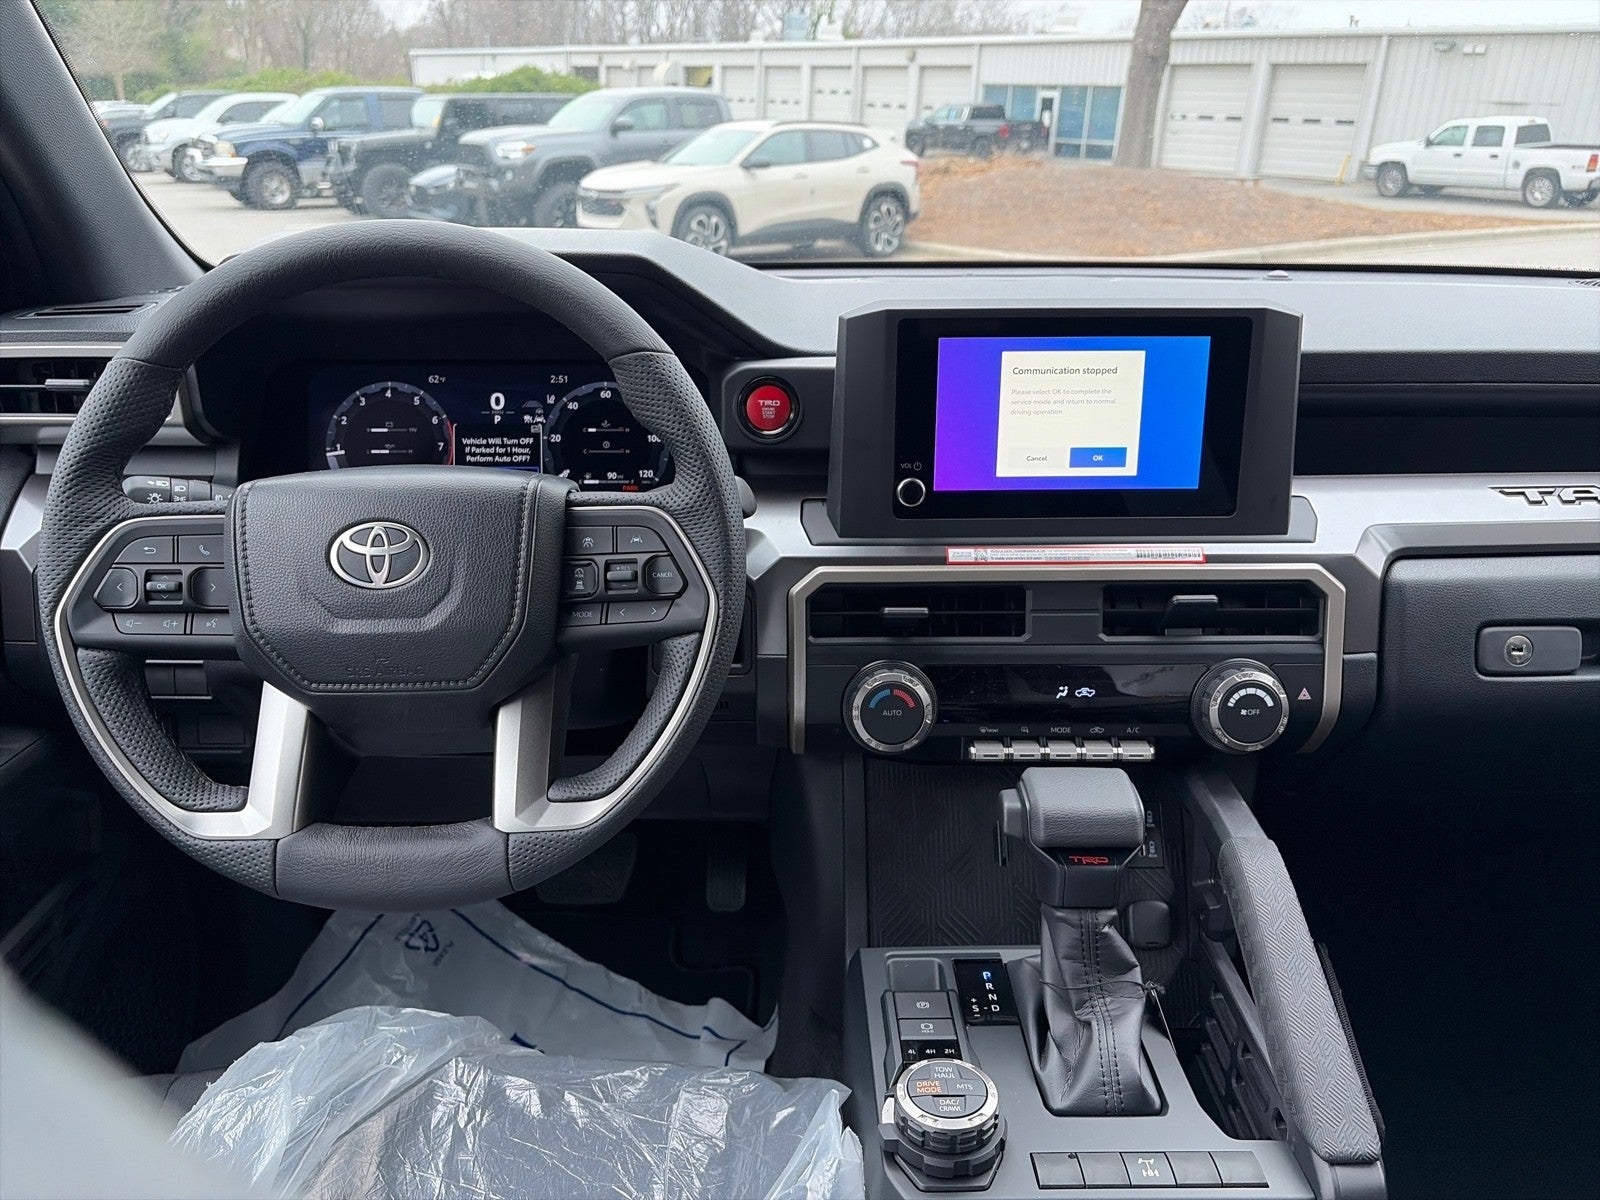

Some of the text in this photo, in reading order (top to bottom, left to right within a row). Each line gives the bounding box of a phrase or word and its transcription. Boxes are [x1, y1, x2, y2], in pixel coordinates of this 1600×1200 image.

[1013, 366, 1118, 376] Communication stopped
[550, 375, 568, 383] 2:51
[385, 390, 391, 398] 4
[360, 398, 366, 406] 3
[414, 396, 420, 405] 5
[490, 392, 505, 410] 0
[341, 416, 347, 425] 2
[432, 416, 438, 424] 6
[494, 415, 501, 424] P
[438, 442, 444, 451] 7
[1069, 856, 1108, 864] TRD
[983, 971, 991, 980] P
